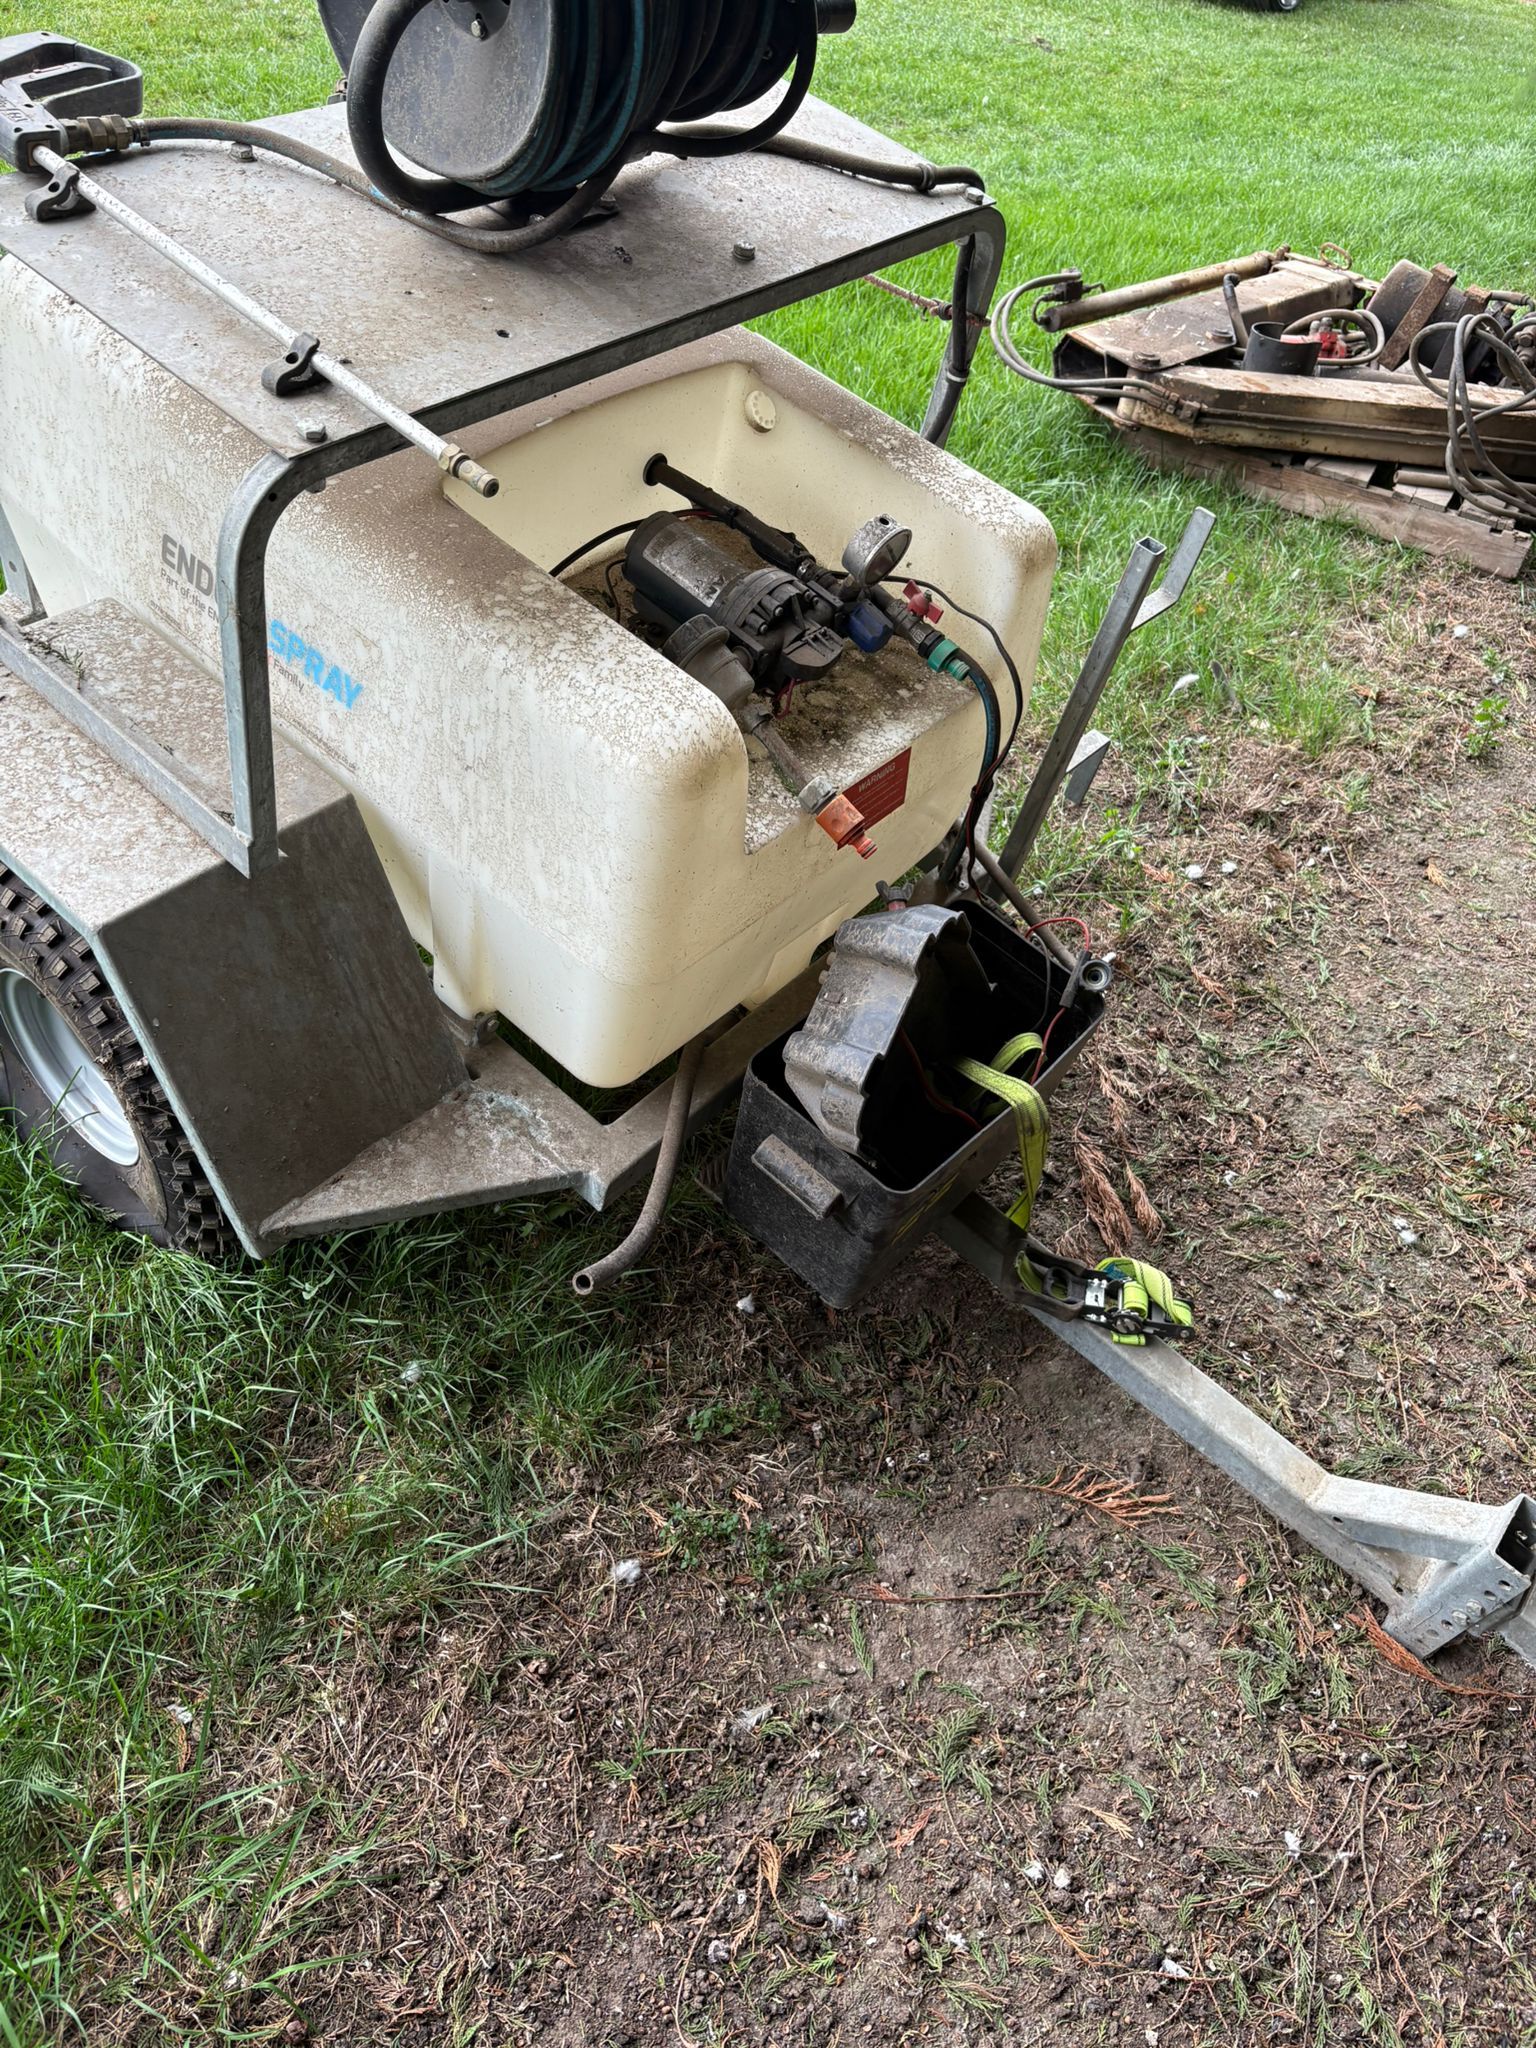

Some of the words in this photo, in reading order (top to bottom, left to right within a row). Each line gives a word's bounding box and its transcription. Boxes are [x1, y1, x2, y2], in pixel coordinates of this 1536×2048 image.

[160, 567, 179, 590] Part
[180, 587, 190, 599] of
[191, 593, 206, 613] the
[269, 619, 364, 710] SPRAY
[273, 659, 305, 693] Family
[858, 762, 896, 793] WARNING
